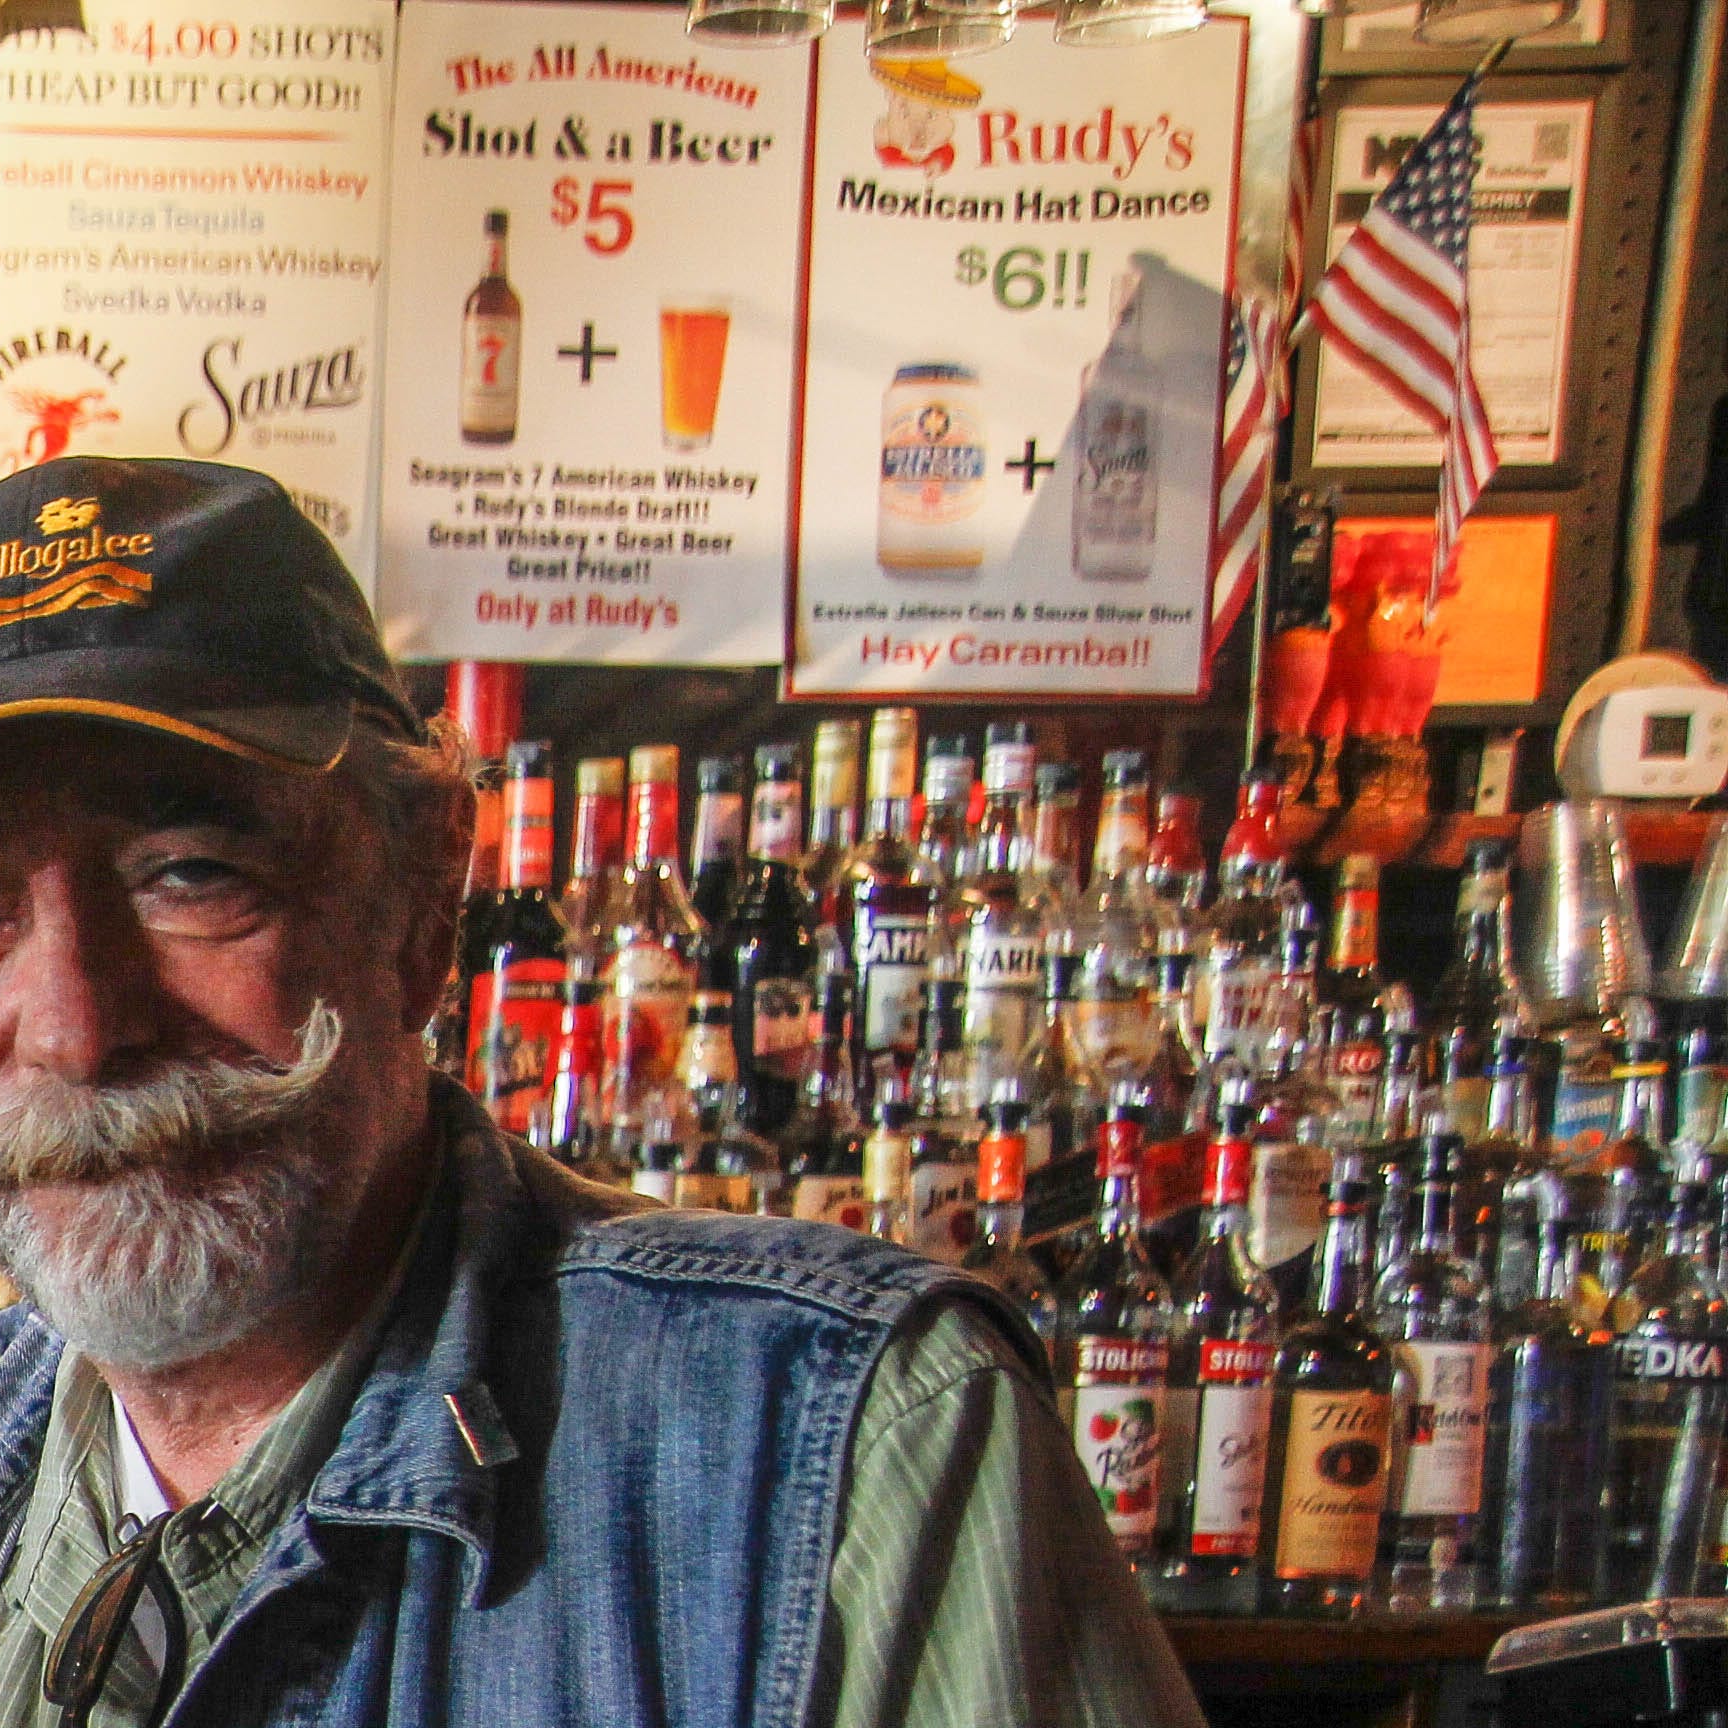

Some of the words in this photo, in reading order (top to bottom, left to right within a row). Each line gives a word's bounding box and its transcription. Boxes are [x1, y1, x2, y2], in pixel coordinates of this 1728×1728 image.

[112, 18, 240, 65] $4.00
[248, 24, 385, 63] SHOTS
[126, 72, 207, 109] BUT
[216, 76, 362, 114] GOOD!!
[446, 52, 518, 97] The
[528, 42, 577, 82] All
[586, 42, 759, 110] American
[423, 110, 539, 159] Shot
[554, 113, 592, 161] &
[605, 131, 633, 162] a
[647, 117, 776, 165] Beer
[974, 106, 1196, 182] Rudy's
[82, 160, 238, 194] Cinnamon
[241, 163, 370, 200] Whiskey
[67, 201, 156, 231] Sauza
[163, 202, 265, 237] Tequila
[550, 175, 637, 258] $5
[835, 179, 1005, 223] Mexican
[1012, 184, 1083, 225] Hat
[1090, 186, 1212, 224] Dance
[110, 244, 254, 275] American
[257, 247, 384, 285] Whiskey
[62, 286, 171, 315] Svedka
[175, 287, 267, 317] Vodka
[178, 335, 367, 457] Sauza
[409, 459, 523, 489] Seagram's
[552, 463, 657, 490] American
[663, 465, 760, 500] Whiskey
[473, 495, 545, 524] Rudy's
[553, 497, 630, 520] Blonde
[428, 521, 489, 548] Great
[495, 526, 591, 558] Whiskey
[614, 527, 675, 552] Great
[681, 529, 735, 553] Beer
[506, 554, 569, 582] Great
[475, 590, 541, 631] Only
[547, 591, 577, 627] at
[584, 590, 680, 634] Rudy's
[968, 602, 1006, 622] Can
[1032, 602, 1090, 624] Sauza
[1093, 603, 1145, 625] Silver
[1147, 603, 1195, 625] Shot
[860, 631, 944, 673] Hay
